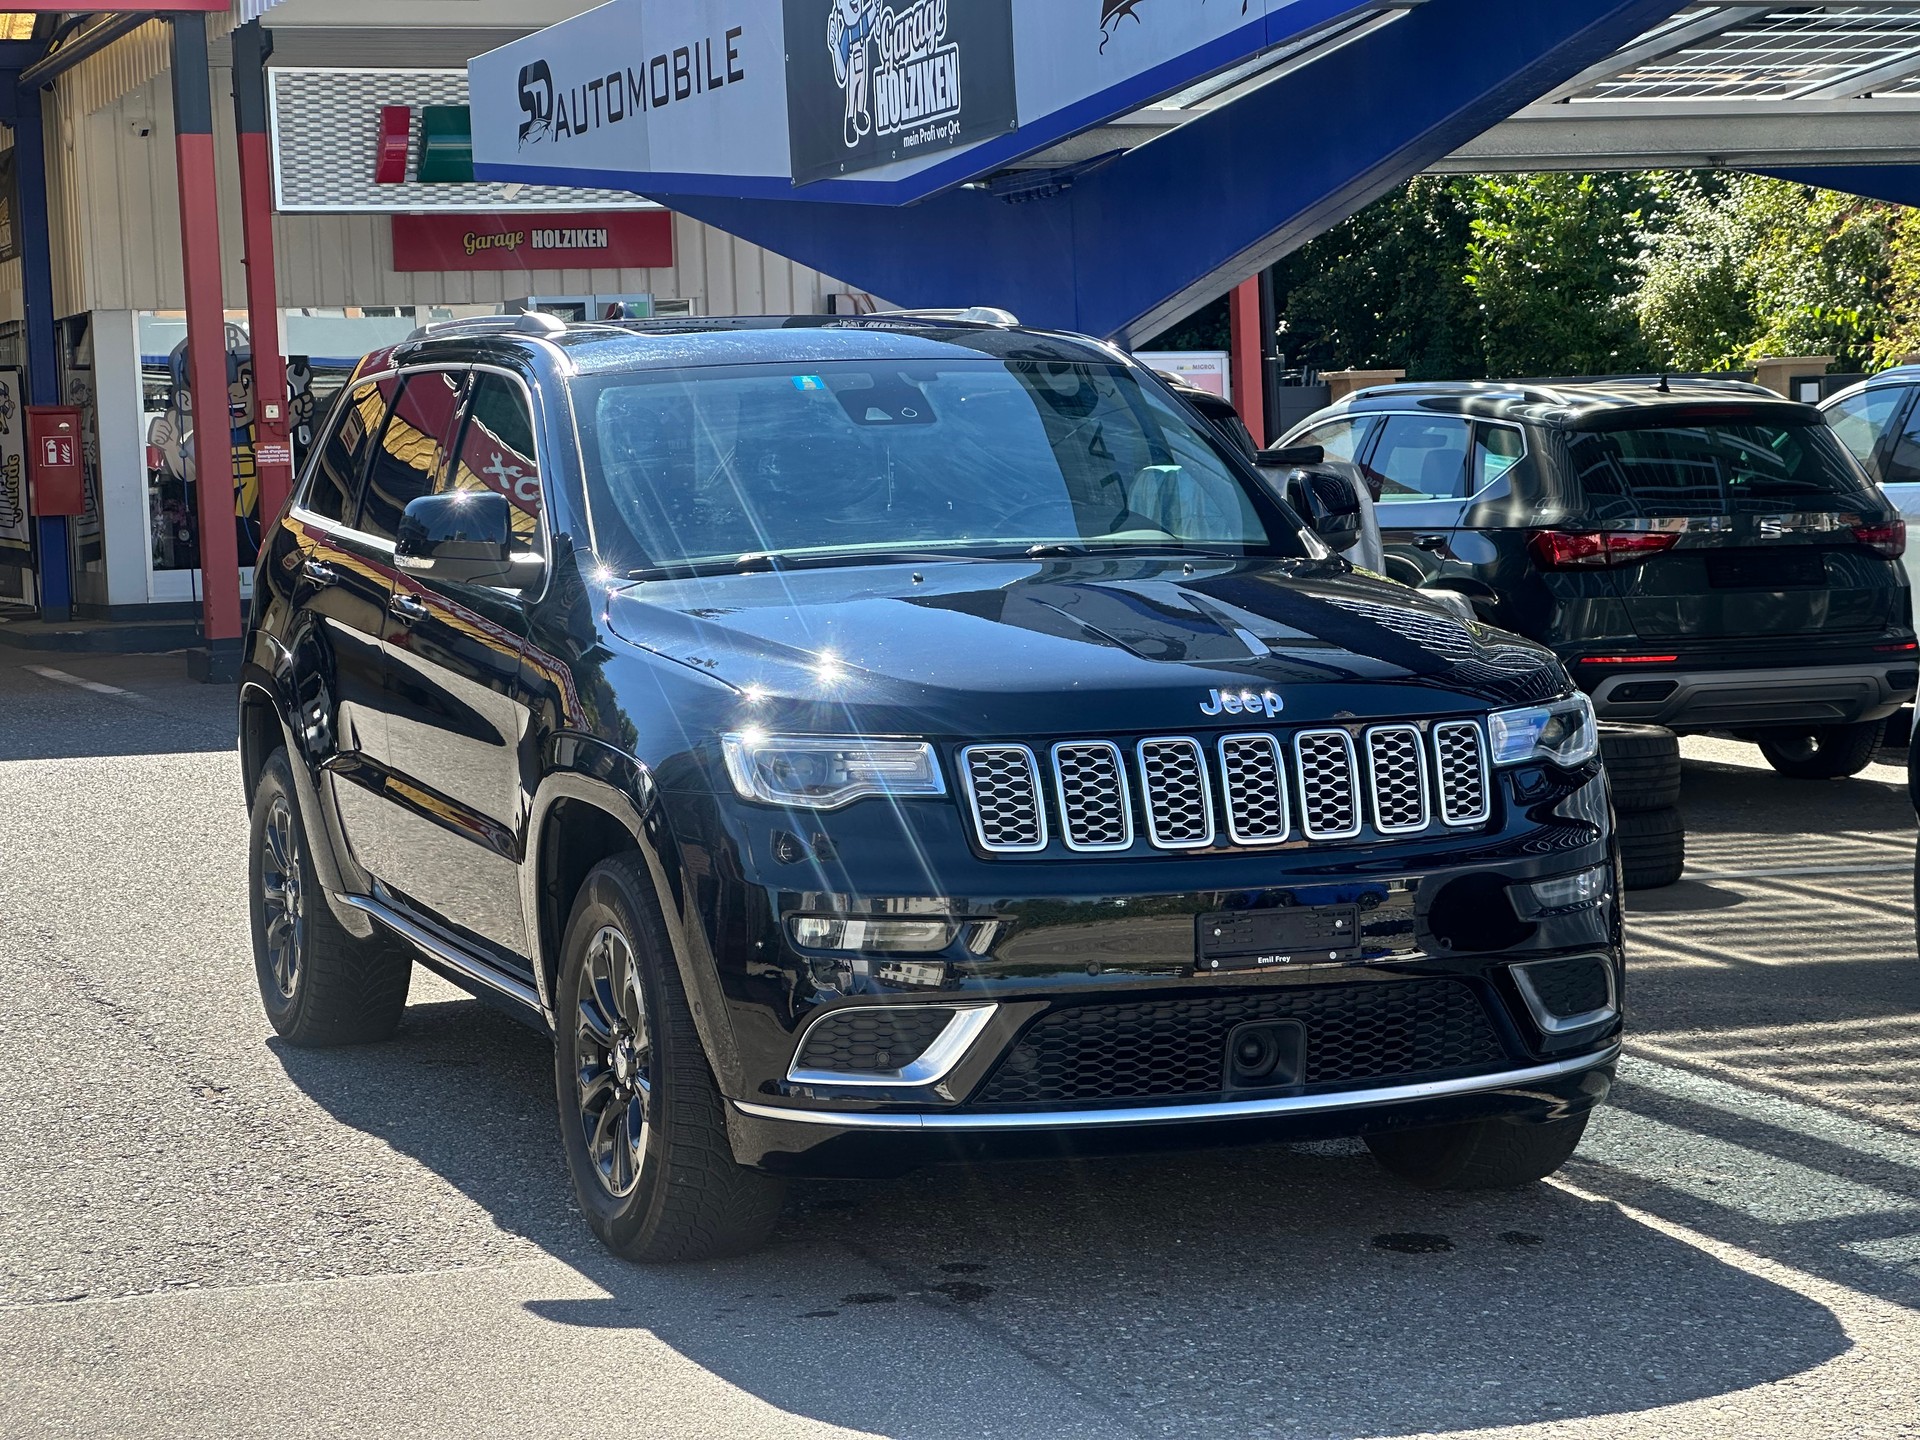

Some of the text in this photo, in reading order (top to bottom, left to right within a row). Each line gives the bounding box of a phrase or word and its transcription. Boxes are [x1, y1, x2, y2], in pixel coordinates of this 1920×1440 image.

[880, 0, 944, 74] Garage
[554, 25, 744, 142] AUTOMOBILE
[876, 51, 959, 127] HOLZIKEN
[903, 120, 960, 147] mein Profi vor Ort
[463, 229, 607, 255] Garage HOLZIKEN
[1200, 688, 1284, 718] Jeep
[1257, 955, 1291, 964] Emil Frey
